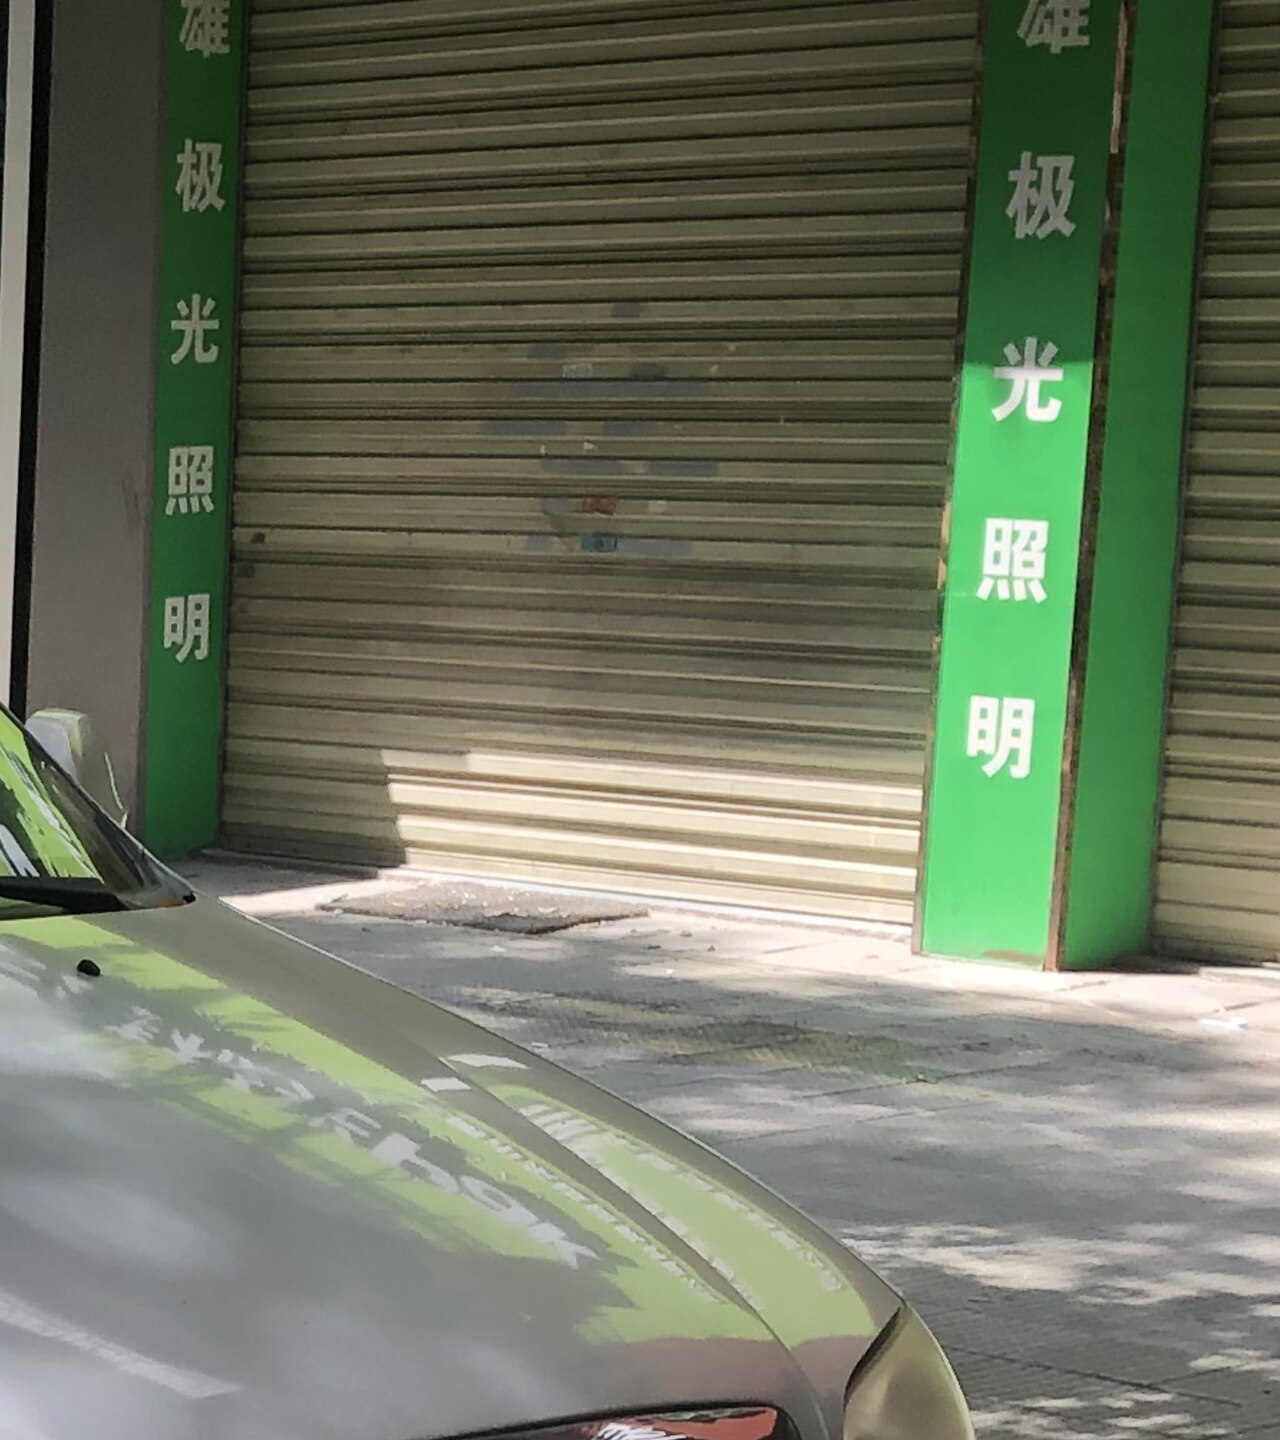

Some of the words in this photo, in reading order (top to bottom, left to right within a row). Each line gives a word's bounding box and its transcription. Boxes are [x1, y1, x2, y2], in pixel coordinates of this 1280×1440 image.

[163, 0, 230, 664] 雄极光照明
[965, 0, 1090, 780] 雄极光照明
